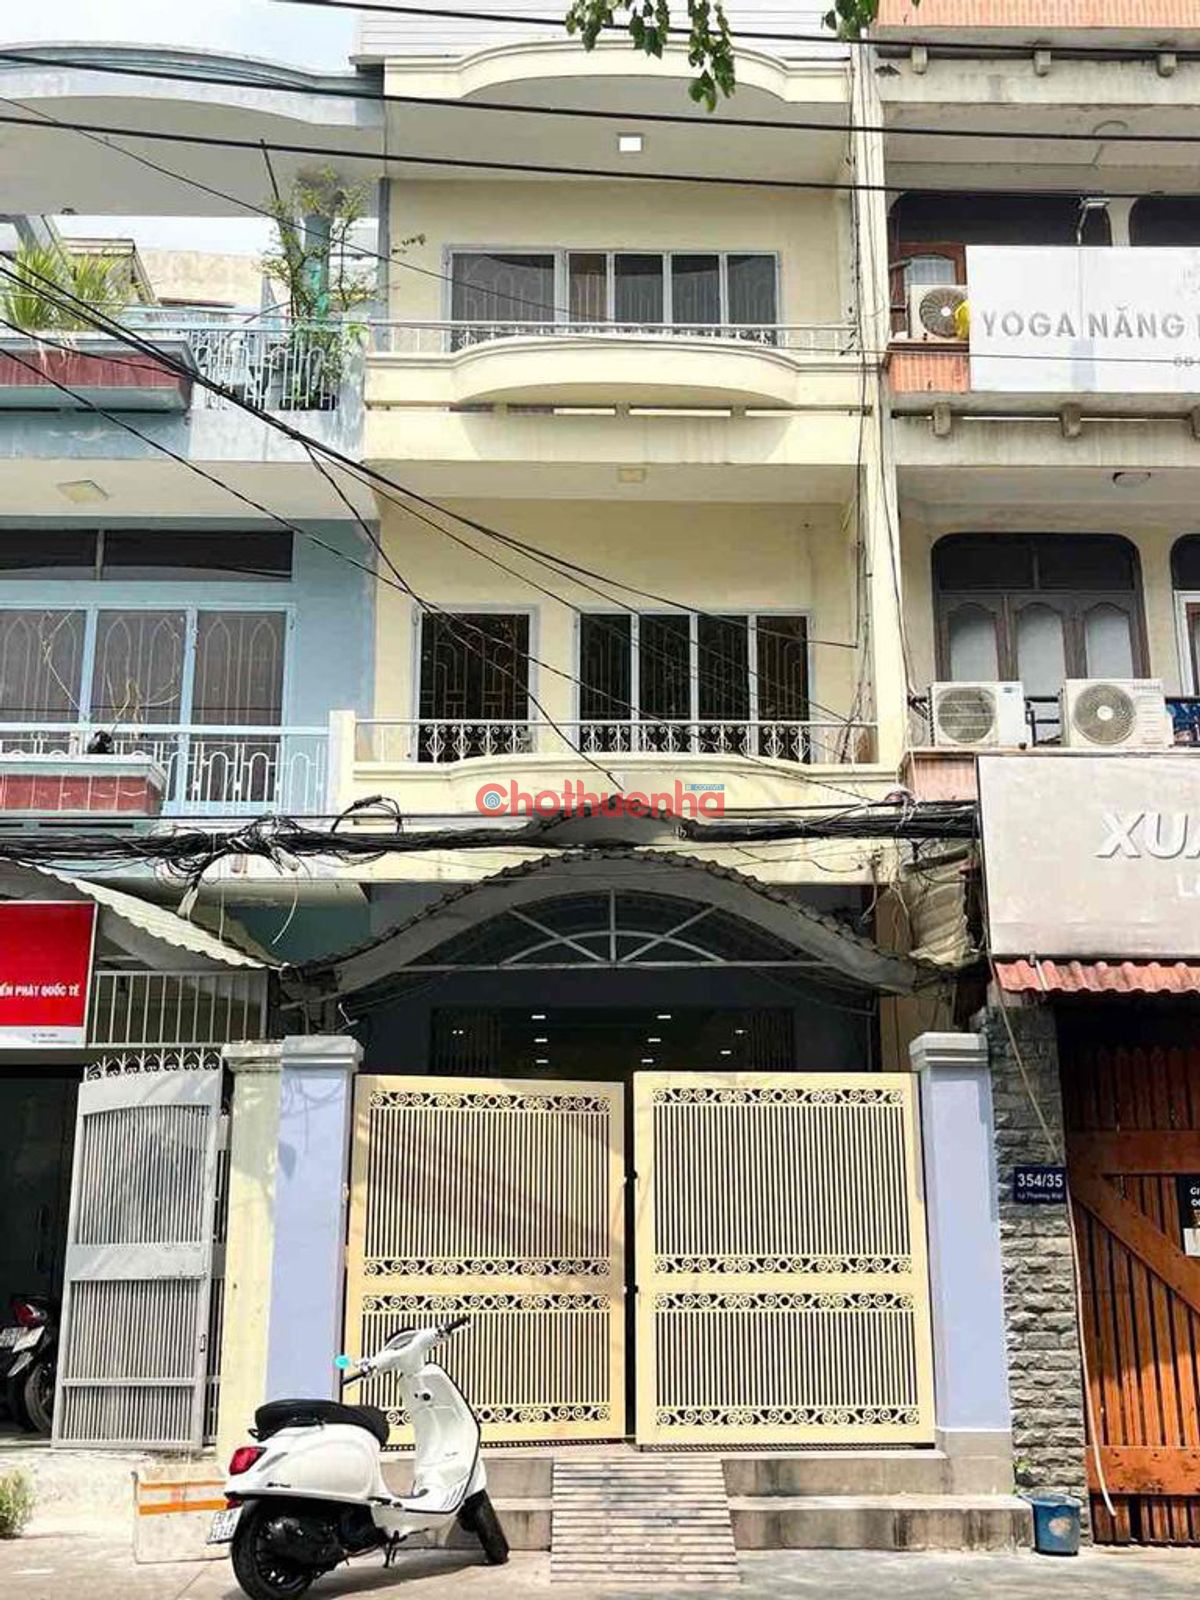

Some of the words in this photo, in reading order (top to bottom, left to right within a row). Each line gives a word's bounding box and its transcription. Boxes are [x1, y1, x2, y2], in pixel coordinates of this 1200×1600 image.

[982, 311, 1075, 338] YOGA
[1089, 305, 1186, 338] NĂNG
[1016, 1172, 1063, 1188] 354/35
